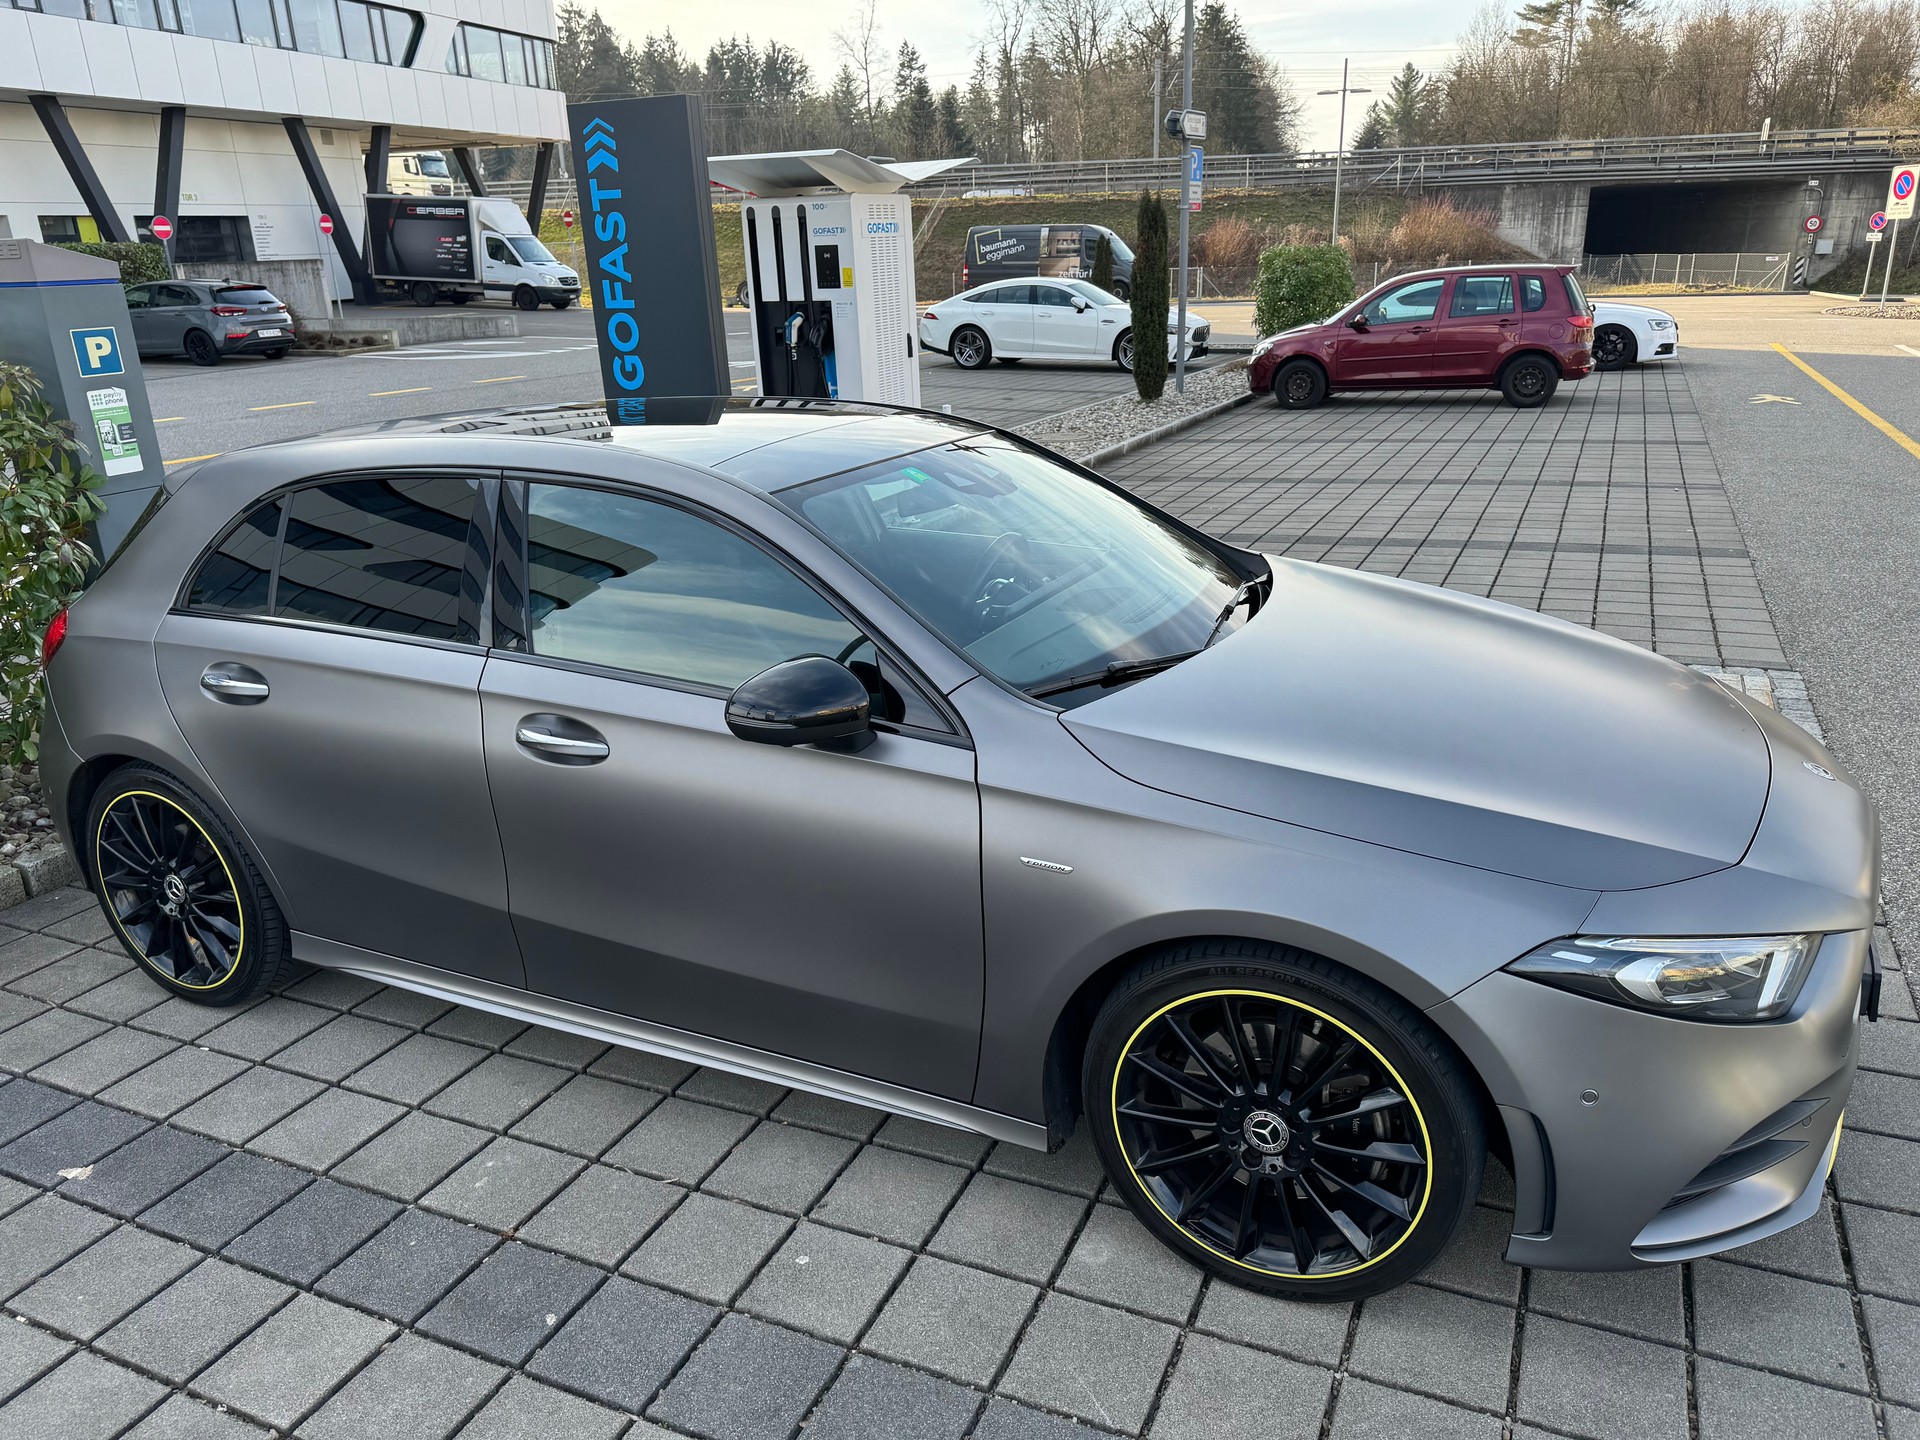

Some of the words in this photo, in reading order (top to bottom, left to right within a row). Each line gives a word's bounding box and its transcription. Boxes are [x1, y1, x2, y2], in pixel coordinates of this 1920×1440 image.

[813, 227, 841, 235] GOFAST
[867, 222, 893, 234] GOFAST
[980, 237, 1017, 253] baumann
[986, 244, 1025, 261] eggimann
[588, 178, 645, 391] GOFAST
[84, 336, 112, 368] P
[1026, 860, 1066, 871] EDITION
[1236, 966, 1296, 984] SEASON
